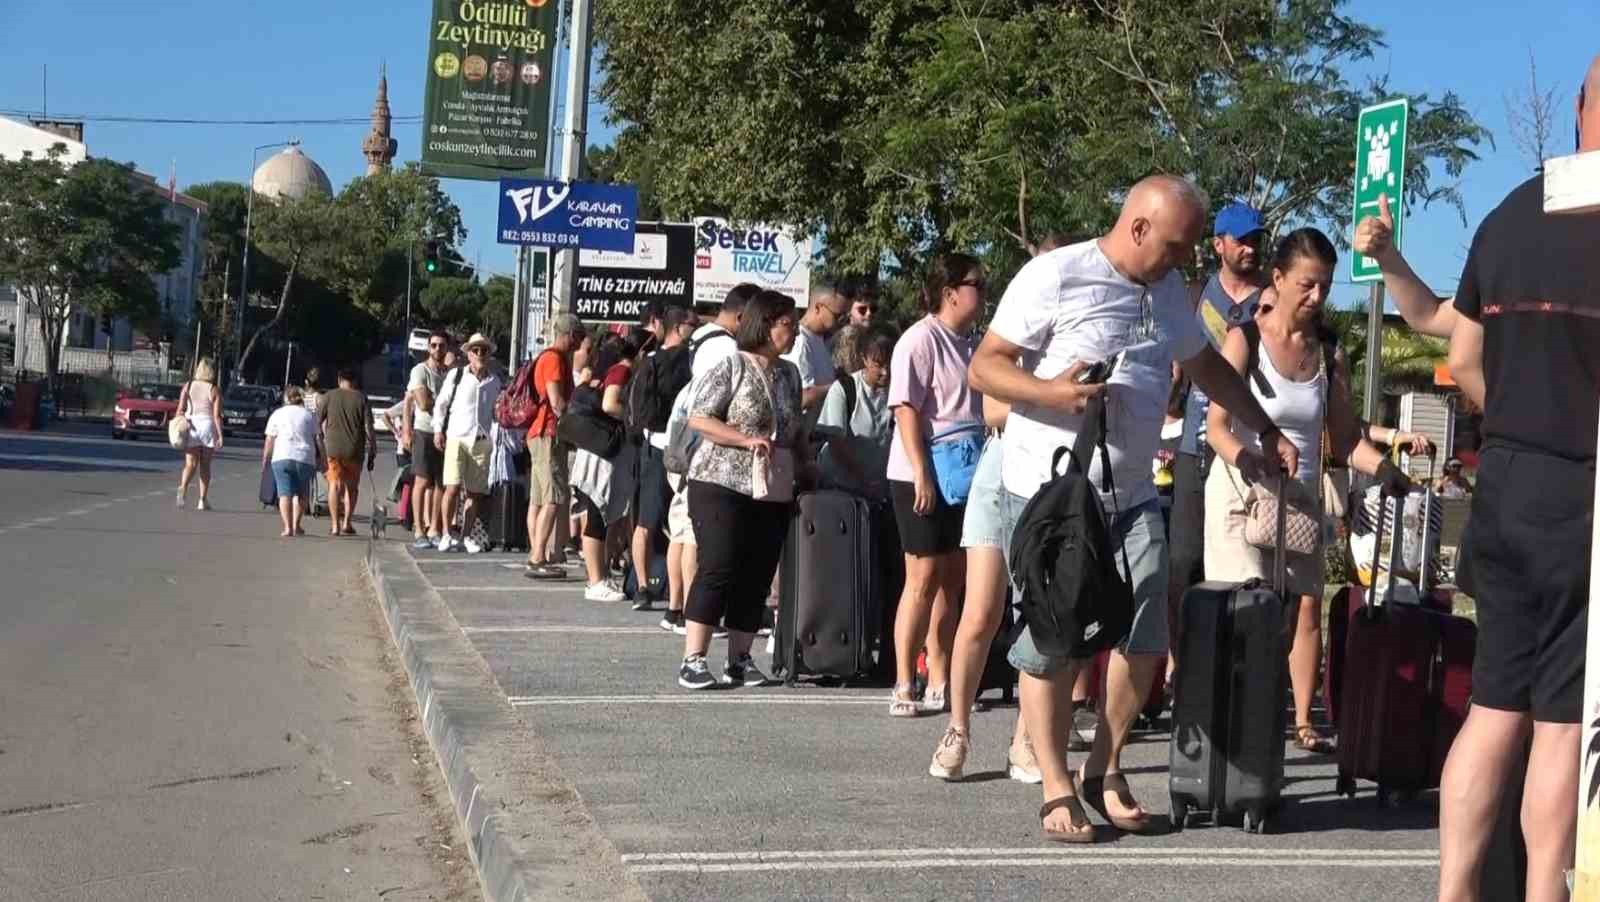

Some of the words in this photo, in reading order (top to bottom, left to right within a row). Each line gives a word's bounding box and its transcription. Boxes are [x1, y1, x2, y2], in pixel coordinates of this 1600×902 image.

[460, 0, 527, 26] Ödüllü
[437, 21, 545, 54] Zeytinyağı
[505, 184, 570, 224] FLY
[567, 200, 622, 214] KARAVAN
[569, 214, 630, 231] CAMPING
[521, 231, 541, 242] 0553
[542, 232, 556, 243] 832
[569, 234, 579, 245] 04
[731, 250, 787, 275] TRAVEL
[604, 278, 614, 293] &
[614, 276, 686, 295] ZEYTİNYAĞI
[576, 298, 609, 318] SATIŞ
